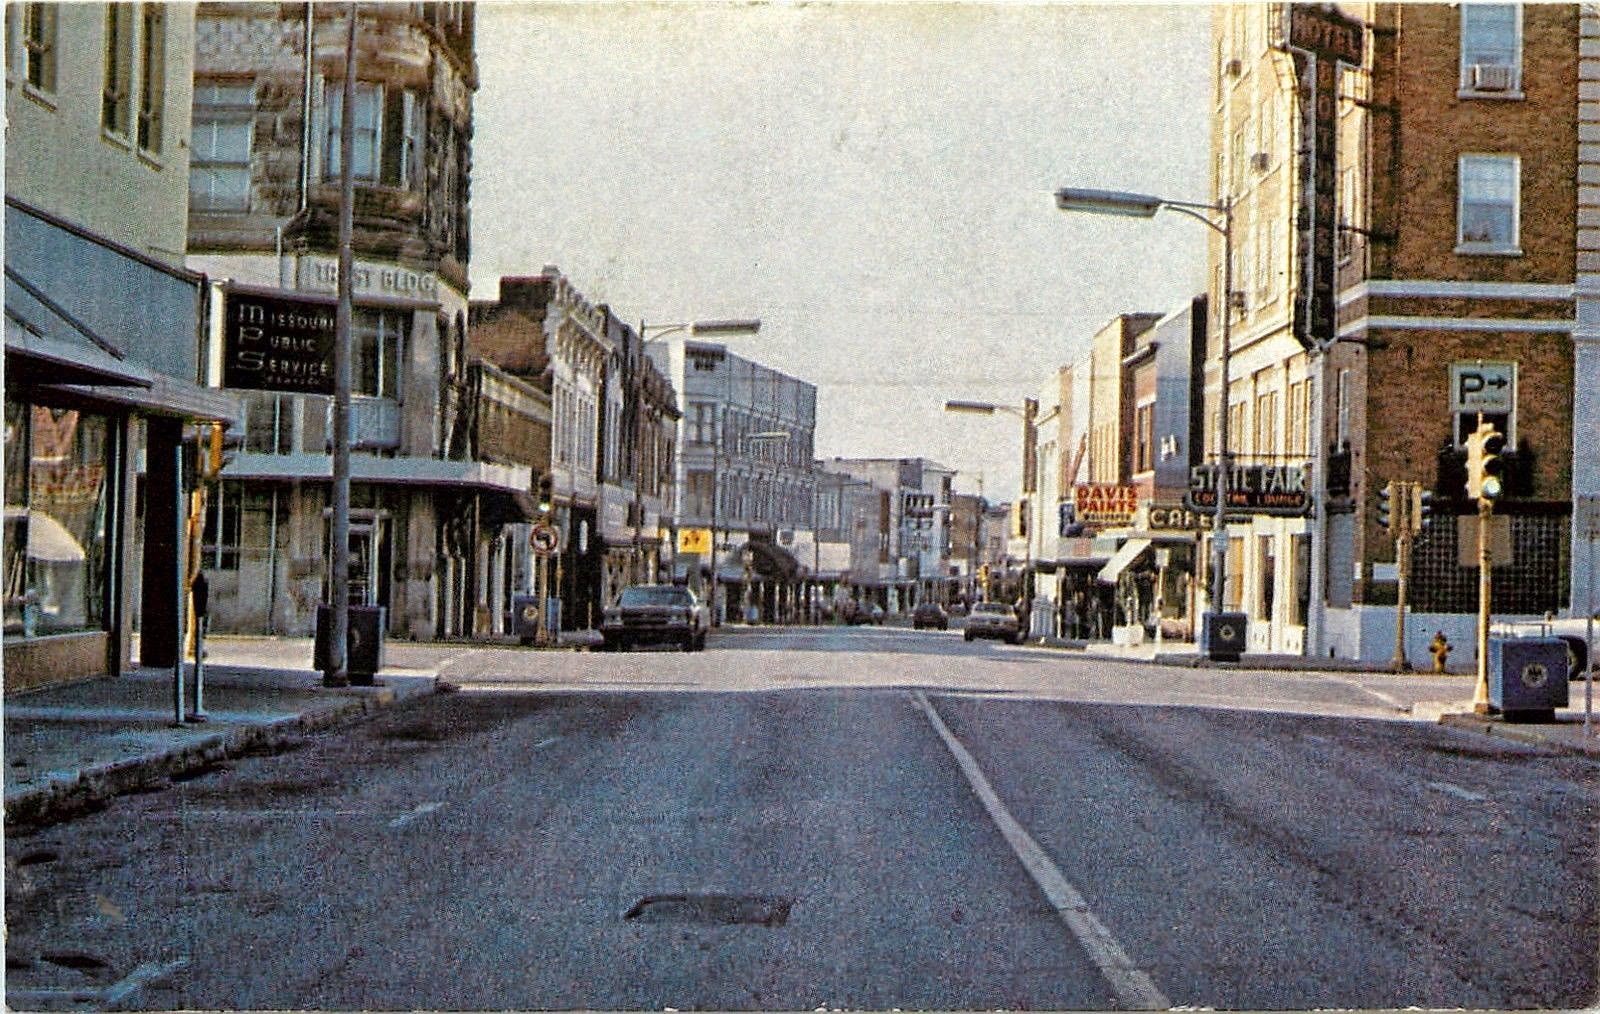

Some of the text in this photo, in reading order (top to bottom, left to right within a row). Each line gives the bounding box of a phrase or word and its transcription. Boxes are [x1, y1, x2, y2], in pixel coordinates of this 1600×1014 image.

[1292, 9, 1358, 59] HOTEL
[379, 267, 437, 294] BLDG
[238, 326, 317, 352] PUBLIC
[236, 351, 328, 377] SERVICE
[1459, 372, 1485, 405] P
[1077, 484, 1138, 499] DAVIS
[1259, 465, 1306, 494] FAIR
[1077, 499, 1137, 513] PAINTS
[1150, 509, 1213, 530] CAFE
